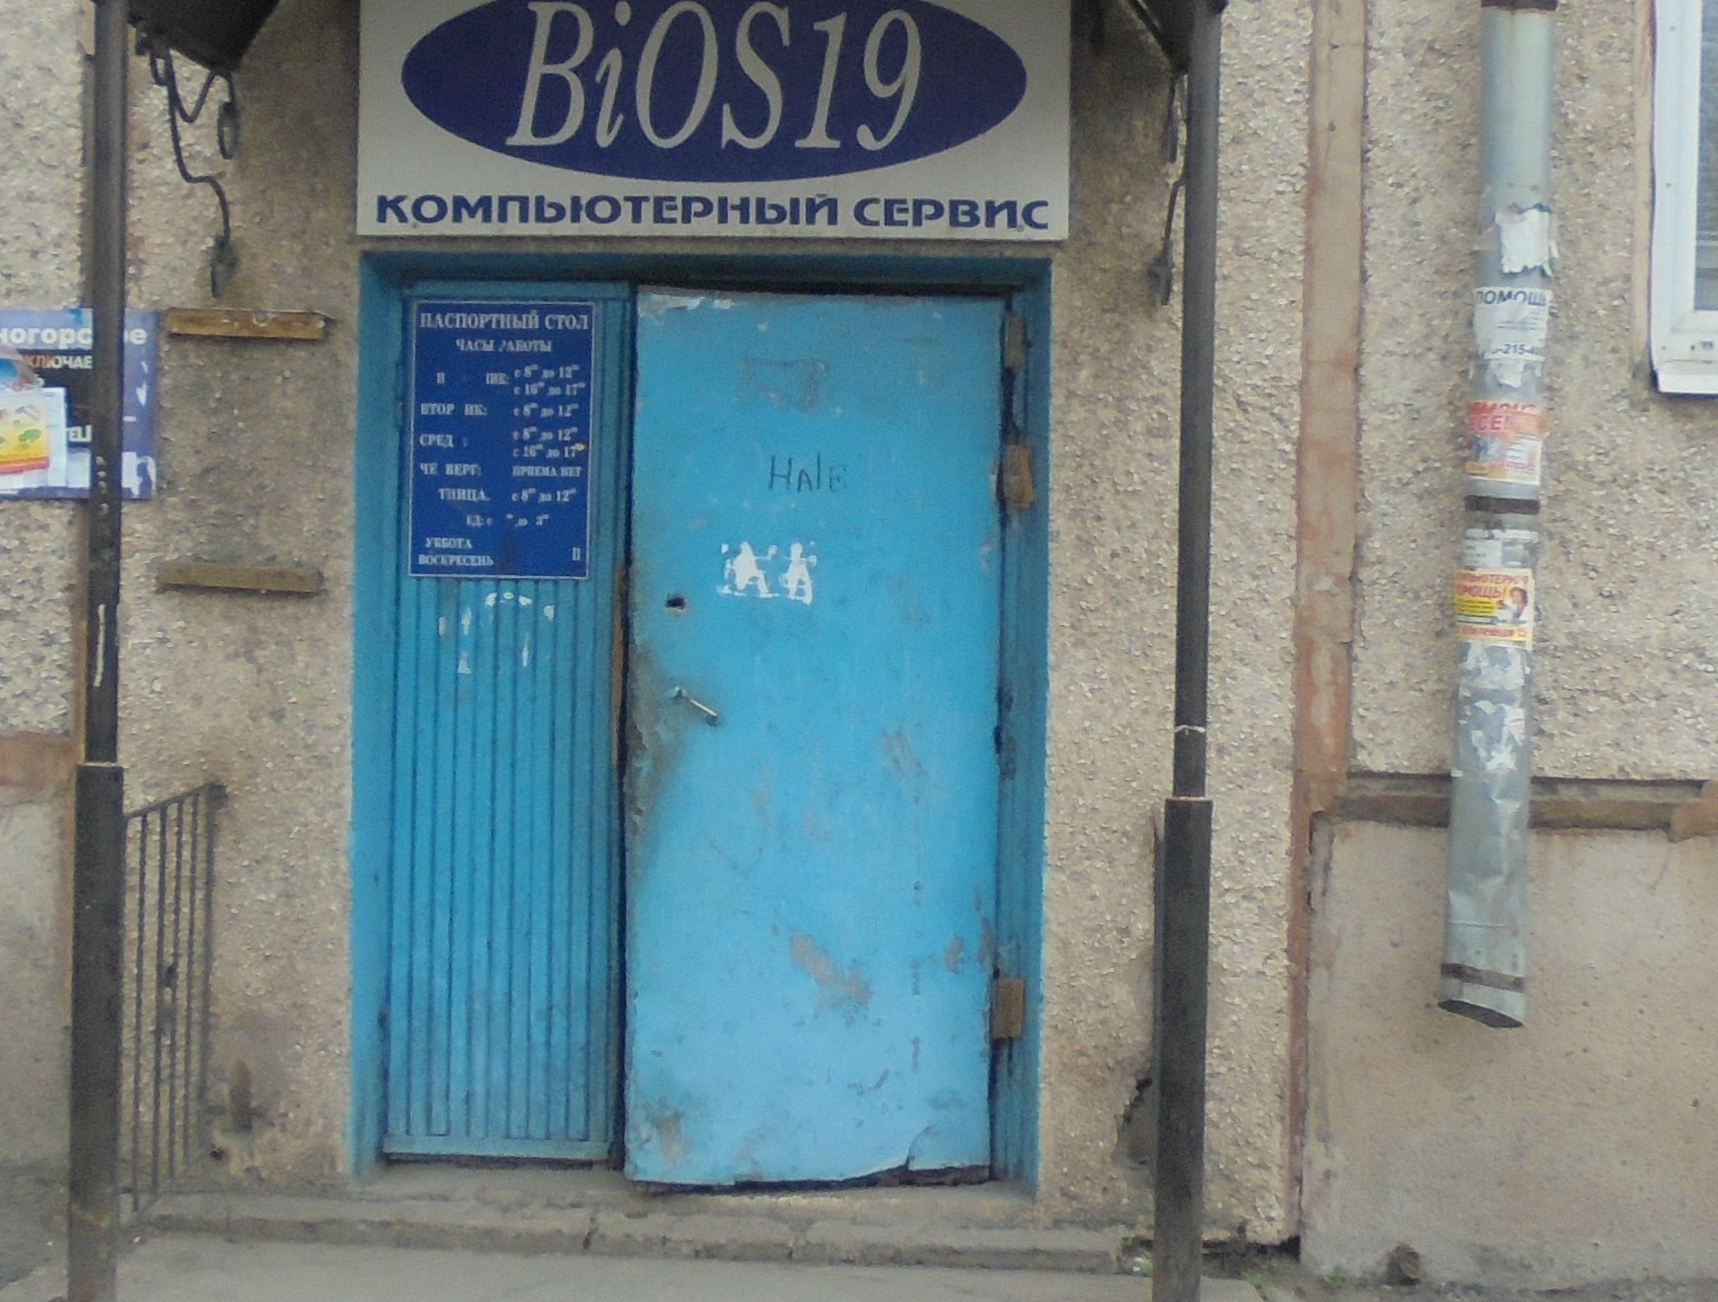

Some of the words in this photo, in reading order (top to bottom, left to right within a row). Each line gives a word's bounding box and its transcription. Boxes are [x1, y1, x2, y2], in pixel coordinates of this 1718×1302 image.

[505, 0, 922, 151] BiOS19
[376, 194, 838, 227] КОМПЬЮТЕРНЫЙ
[853, 199, 1049, 230] СЕРВИС
[420, 309, 539, 329] ПАСПОРТНЫЙ
[545, 314, 588, 329] СТОЛ
[456, 339, 494, 351] ЧАСЫ
